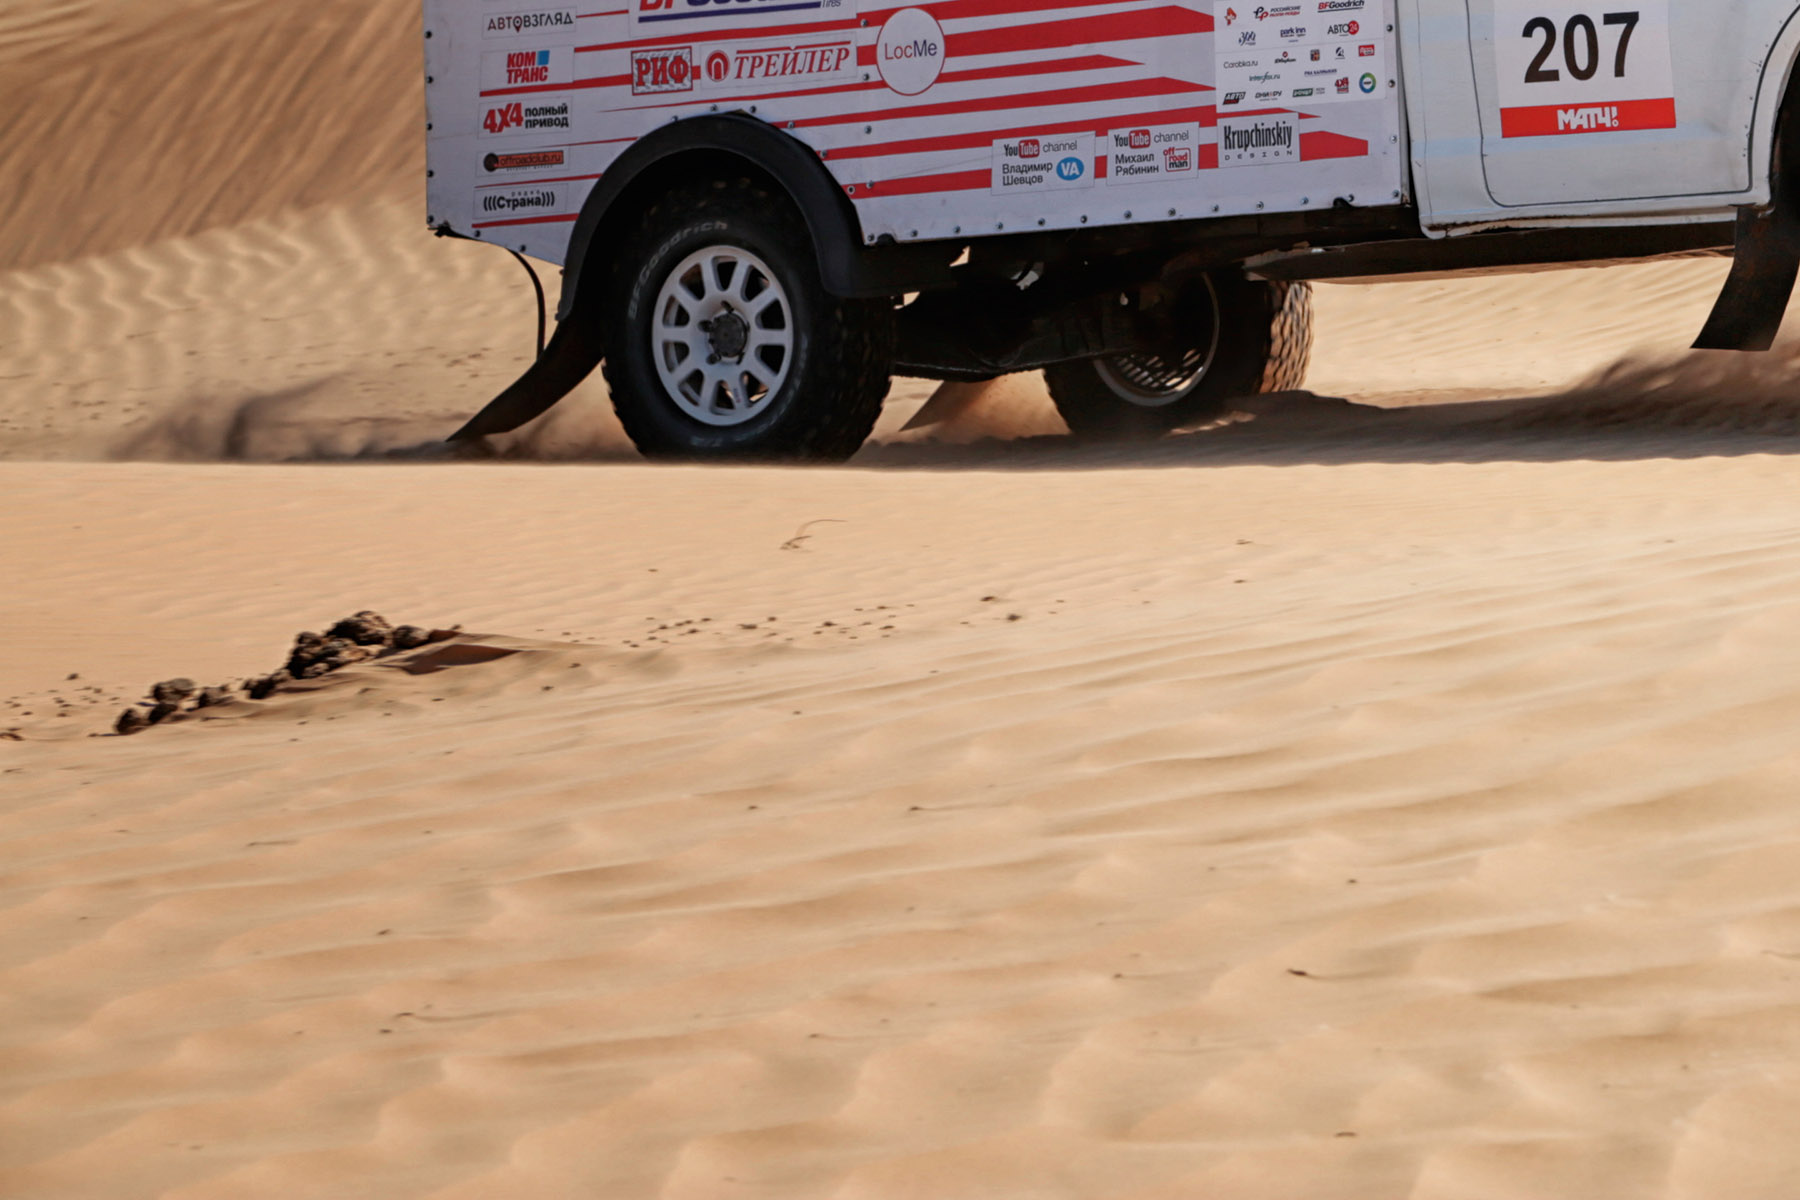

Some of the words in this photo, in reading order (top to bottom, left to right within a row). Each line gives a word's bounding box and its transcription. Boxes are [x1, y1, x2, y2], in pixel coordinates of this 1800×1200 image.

[1318, 0, 1365, 11] BFGoodrich
[487, 11, 574, 33] АВТОВЗГЛЯД
[884, 38, 938, 60] LocMe
[1521, 11, 1640, 84] 207
[506, 51, 537, 68] КОМ
[734, 46, 850, 80] ТРЕЙЛЕР
[506, 66, 549, 85] ТРАНС
[635, 55, 690, 87] РИФ
[524, 102, 568, 118] ПОЛНЫЙ
[524, 117, 570, 130] ПРИВОД
[1556, 106, 1620, 132] МАТЧ!
[1113, 131, 1150, 147] YouTube
[1153, 129, 1190, 144] channel
[1223, 120, 1293, 152] Krupchinskiy
[1003, 142, 1039, 157] YouTube
[1042, 139, 1078, 153] channel
[1115, 153, 1155, 165] Михаил
[1168, 160, 1188, 169] man
[1002, 161, 1053, 175] Владимир
[1060, 161, 1081, 177] VA
[1115, 164, 1160, 177] Рябинин
[1002, 174, 1044, 187] Шевцов
